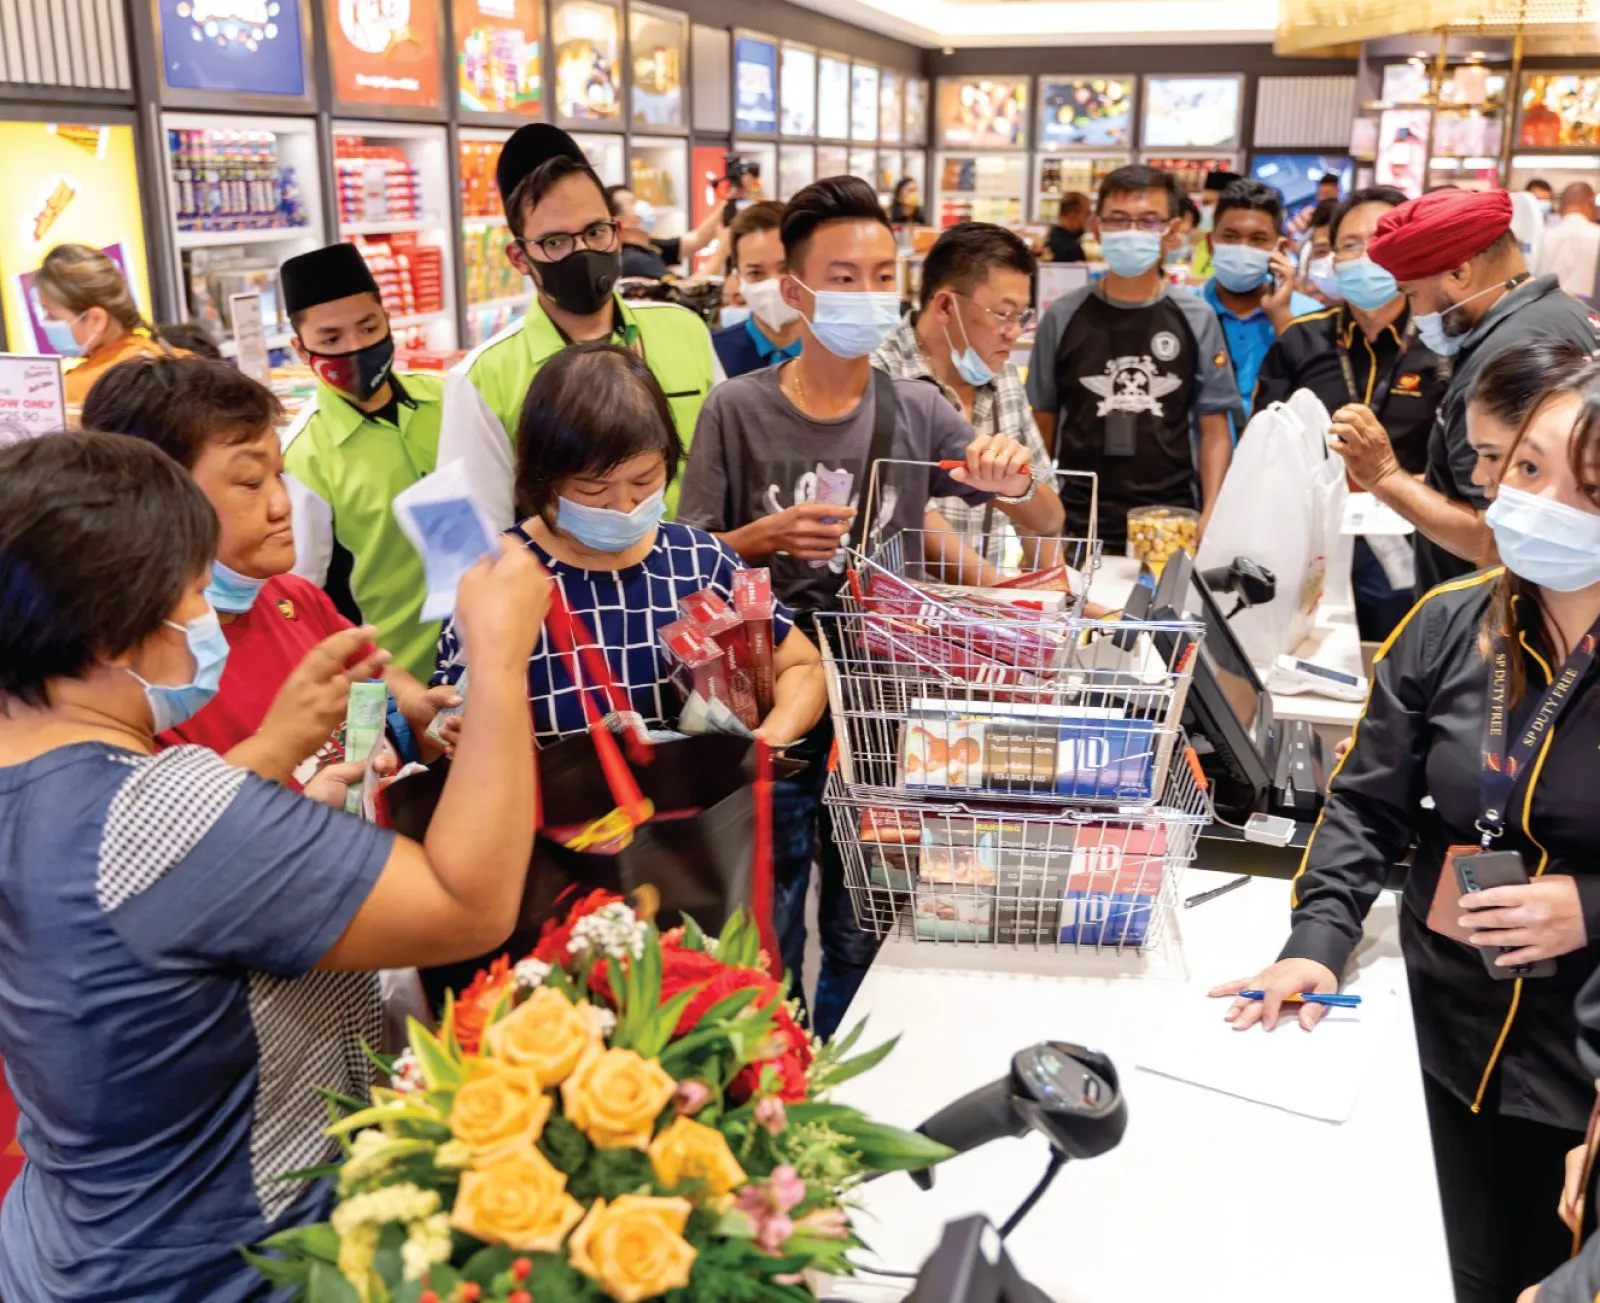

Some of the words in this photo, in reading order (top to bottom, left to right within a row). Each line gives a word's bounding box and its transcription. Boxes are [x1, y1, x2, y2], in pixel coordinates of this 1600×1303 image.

[1495, 653, 1507, 668] SP
[1492, 669, 1507, 703] DUTY
[1489, 706, 1504, 736] FREE
[1522, 731, 1537, 747] SP
[1534, 697, 1559, 732] DUTY
[1552, 667, 1579, 698] FREE
[1077, 736, 1110, 772] LD
